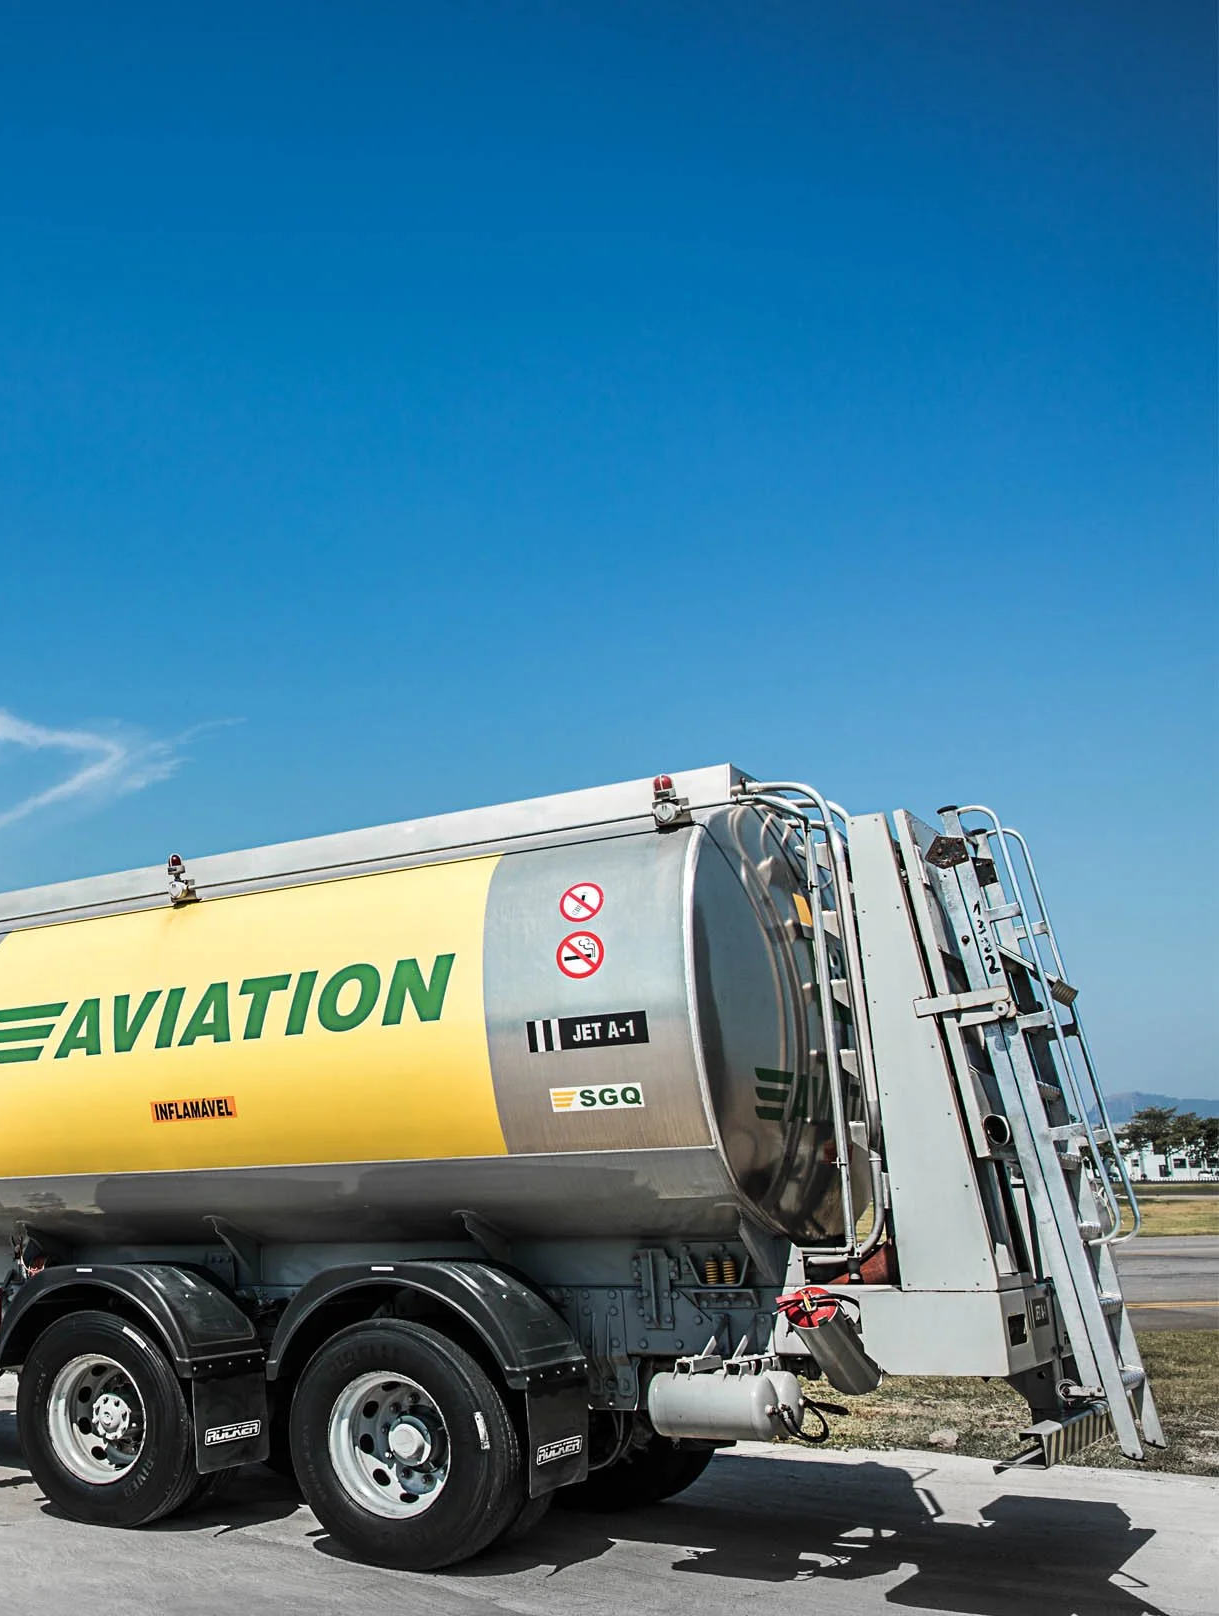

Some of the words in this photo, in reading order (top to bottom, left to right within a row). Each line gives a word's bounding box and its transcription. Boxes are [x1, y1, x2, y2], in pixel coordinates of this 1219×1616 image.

[53, 952, 456, 1059] AVIATION
[572, 1021, 602, 1042] JET
[608, 1019, 636, 1039] A-1
[579, 1086, 642, 1107] SGQ
[154, 1098, 233, 1121] INFLAMÁVEL
